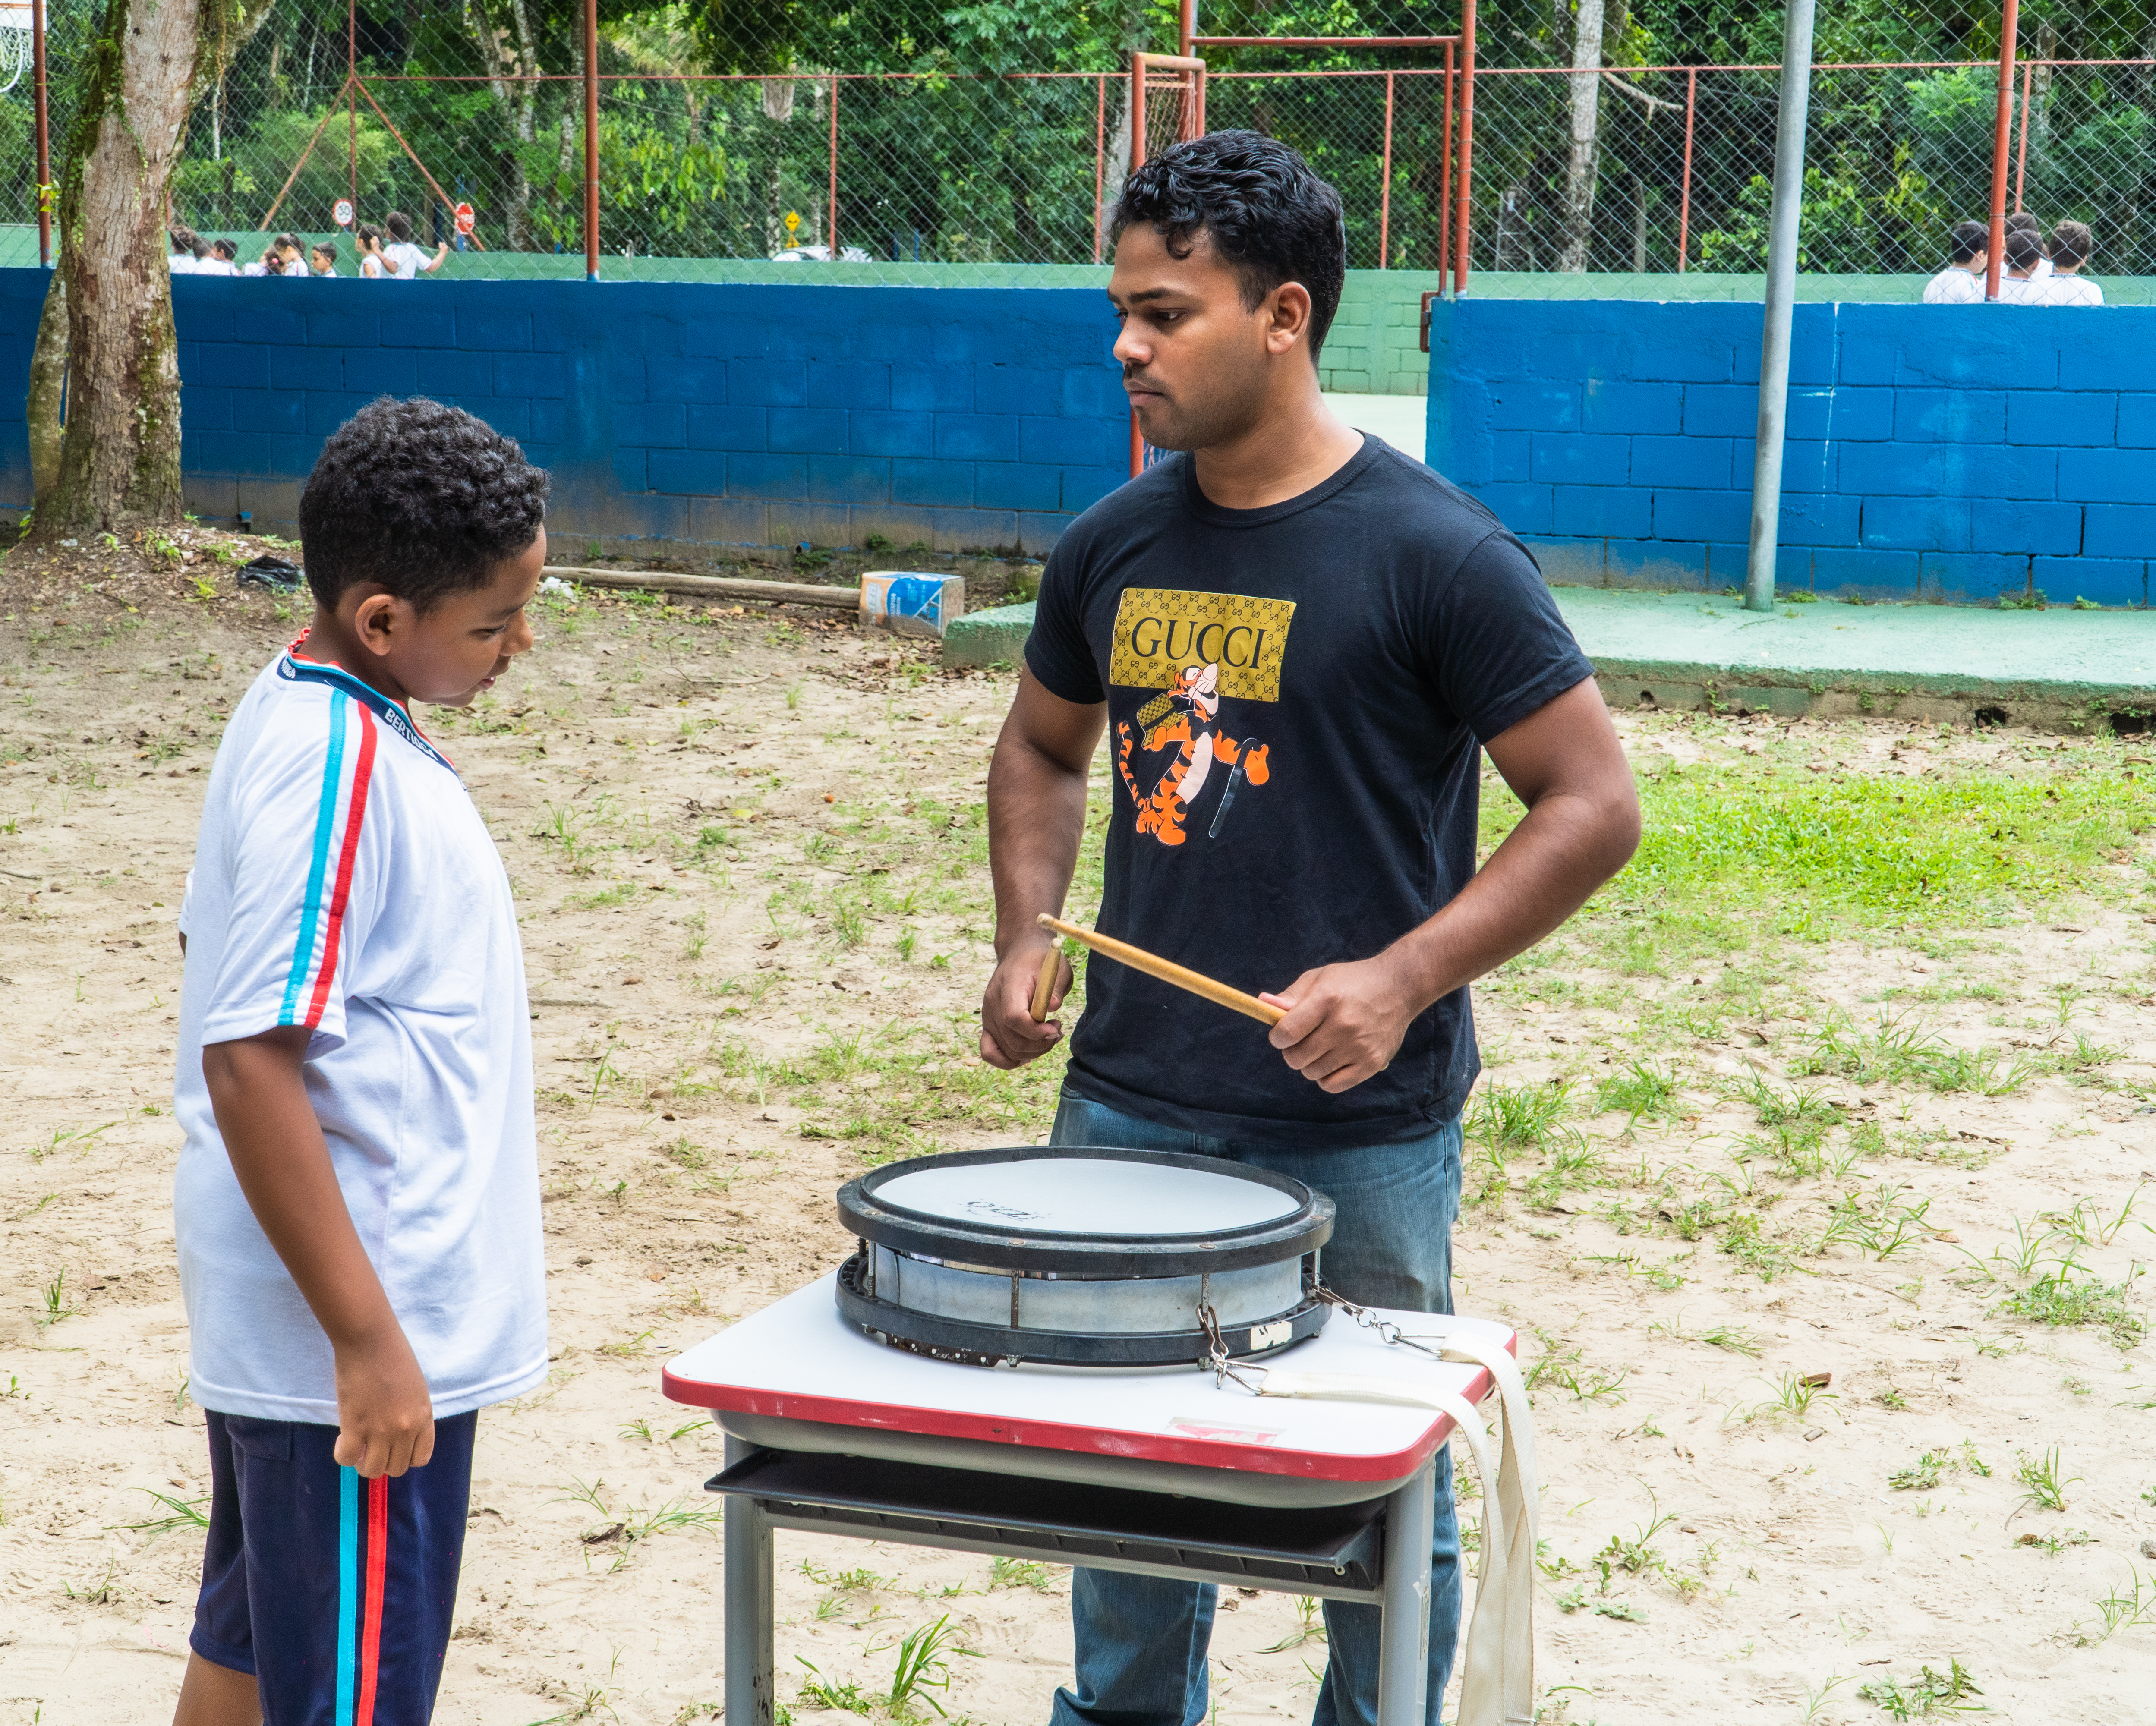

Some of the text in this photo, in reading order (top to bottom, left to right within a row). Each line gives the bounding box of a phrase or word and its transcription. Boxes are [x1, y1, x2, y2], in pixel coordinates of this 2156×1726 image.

[338, 206, 350, 215] 30
[1131, 617, 1267, 669] GUCCI
[384, 707, 438, 761] BERTIOGA
